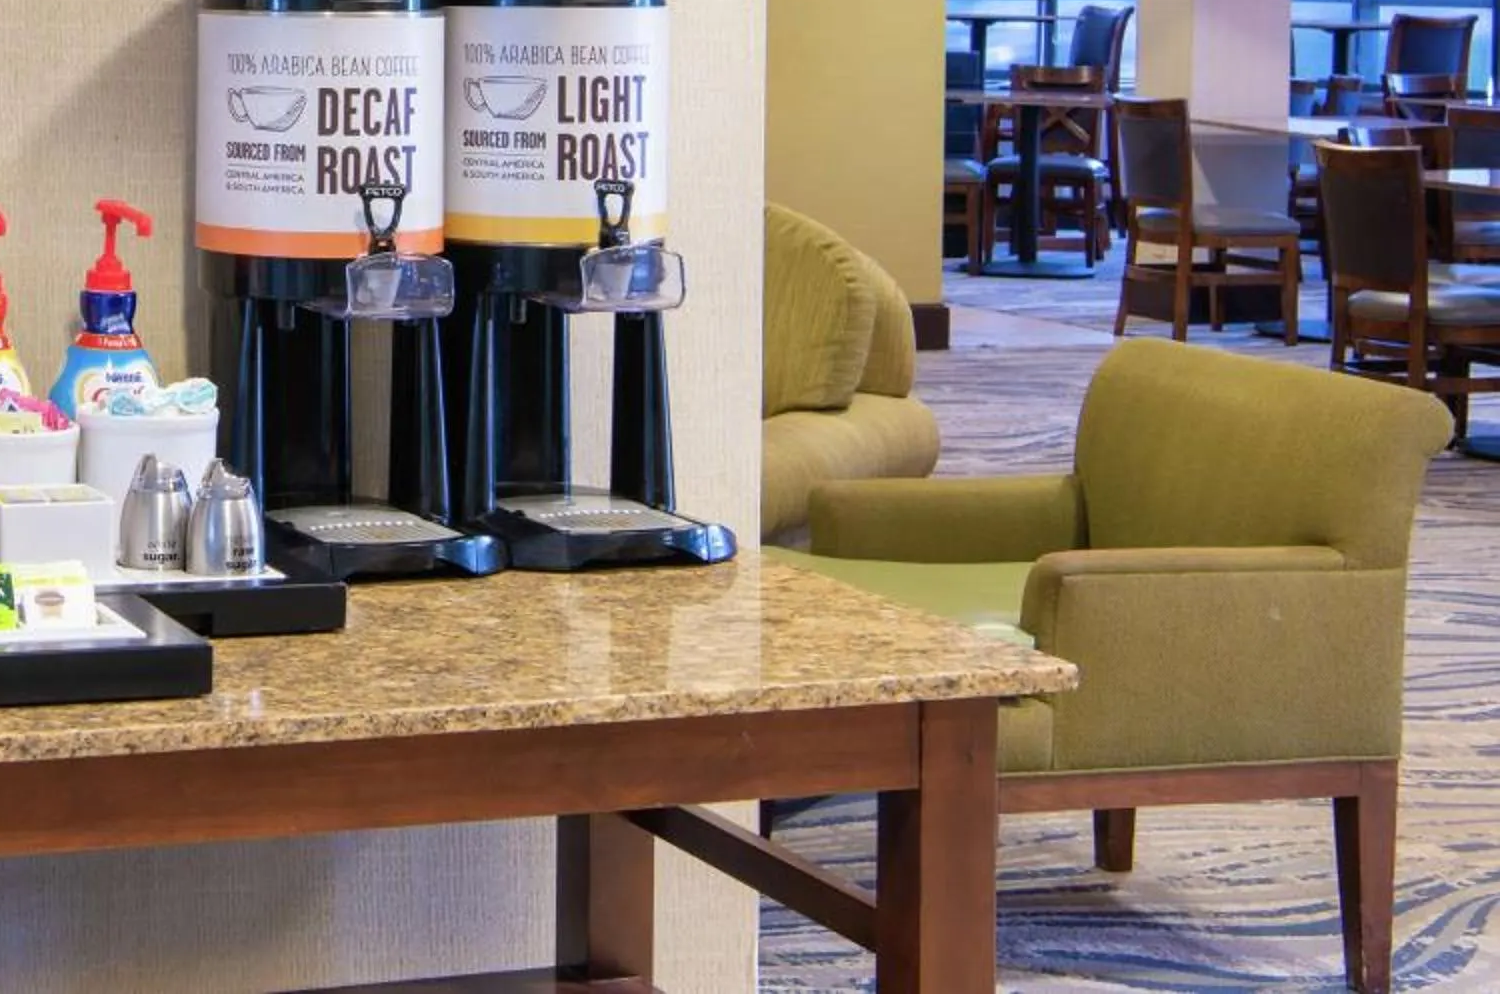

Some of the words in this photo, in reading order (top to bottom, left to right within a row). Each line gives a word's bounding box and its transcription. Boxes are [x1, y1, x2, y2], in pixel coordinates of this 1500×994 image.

[228, 53, 257, 75] 100%
[261, 54, 325, 76] ARABICA
[331, 55, 370, 77] BEAN
[464, 43, 495, 64] 100%
[499, 44, 564, 65] ARABICA
[571, 45, 607, 65] BEAN
[317, 87, 417, 136] DECAF
[557, 75, 646, 124] LIGHT
[226, 141, 271, 161] SOURCED
[273, 143, 307, 162] FROM
[463, 130, 509, 149] SOURCED
[513, 131, 547, 149] FROM
[557, 132, 649, 180] ROAST
[316, 145, 416, 195] ROAST
[365, 187, 402, 197] FETCO
